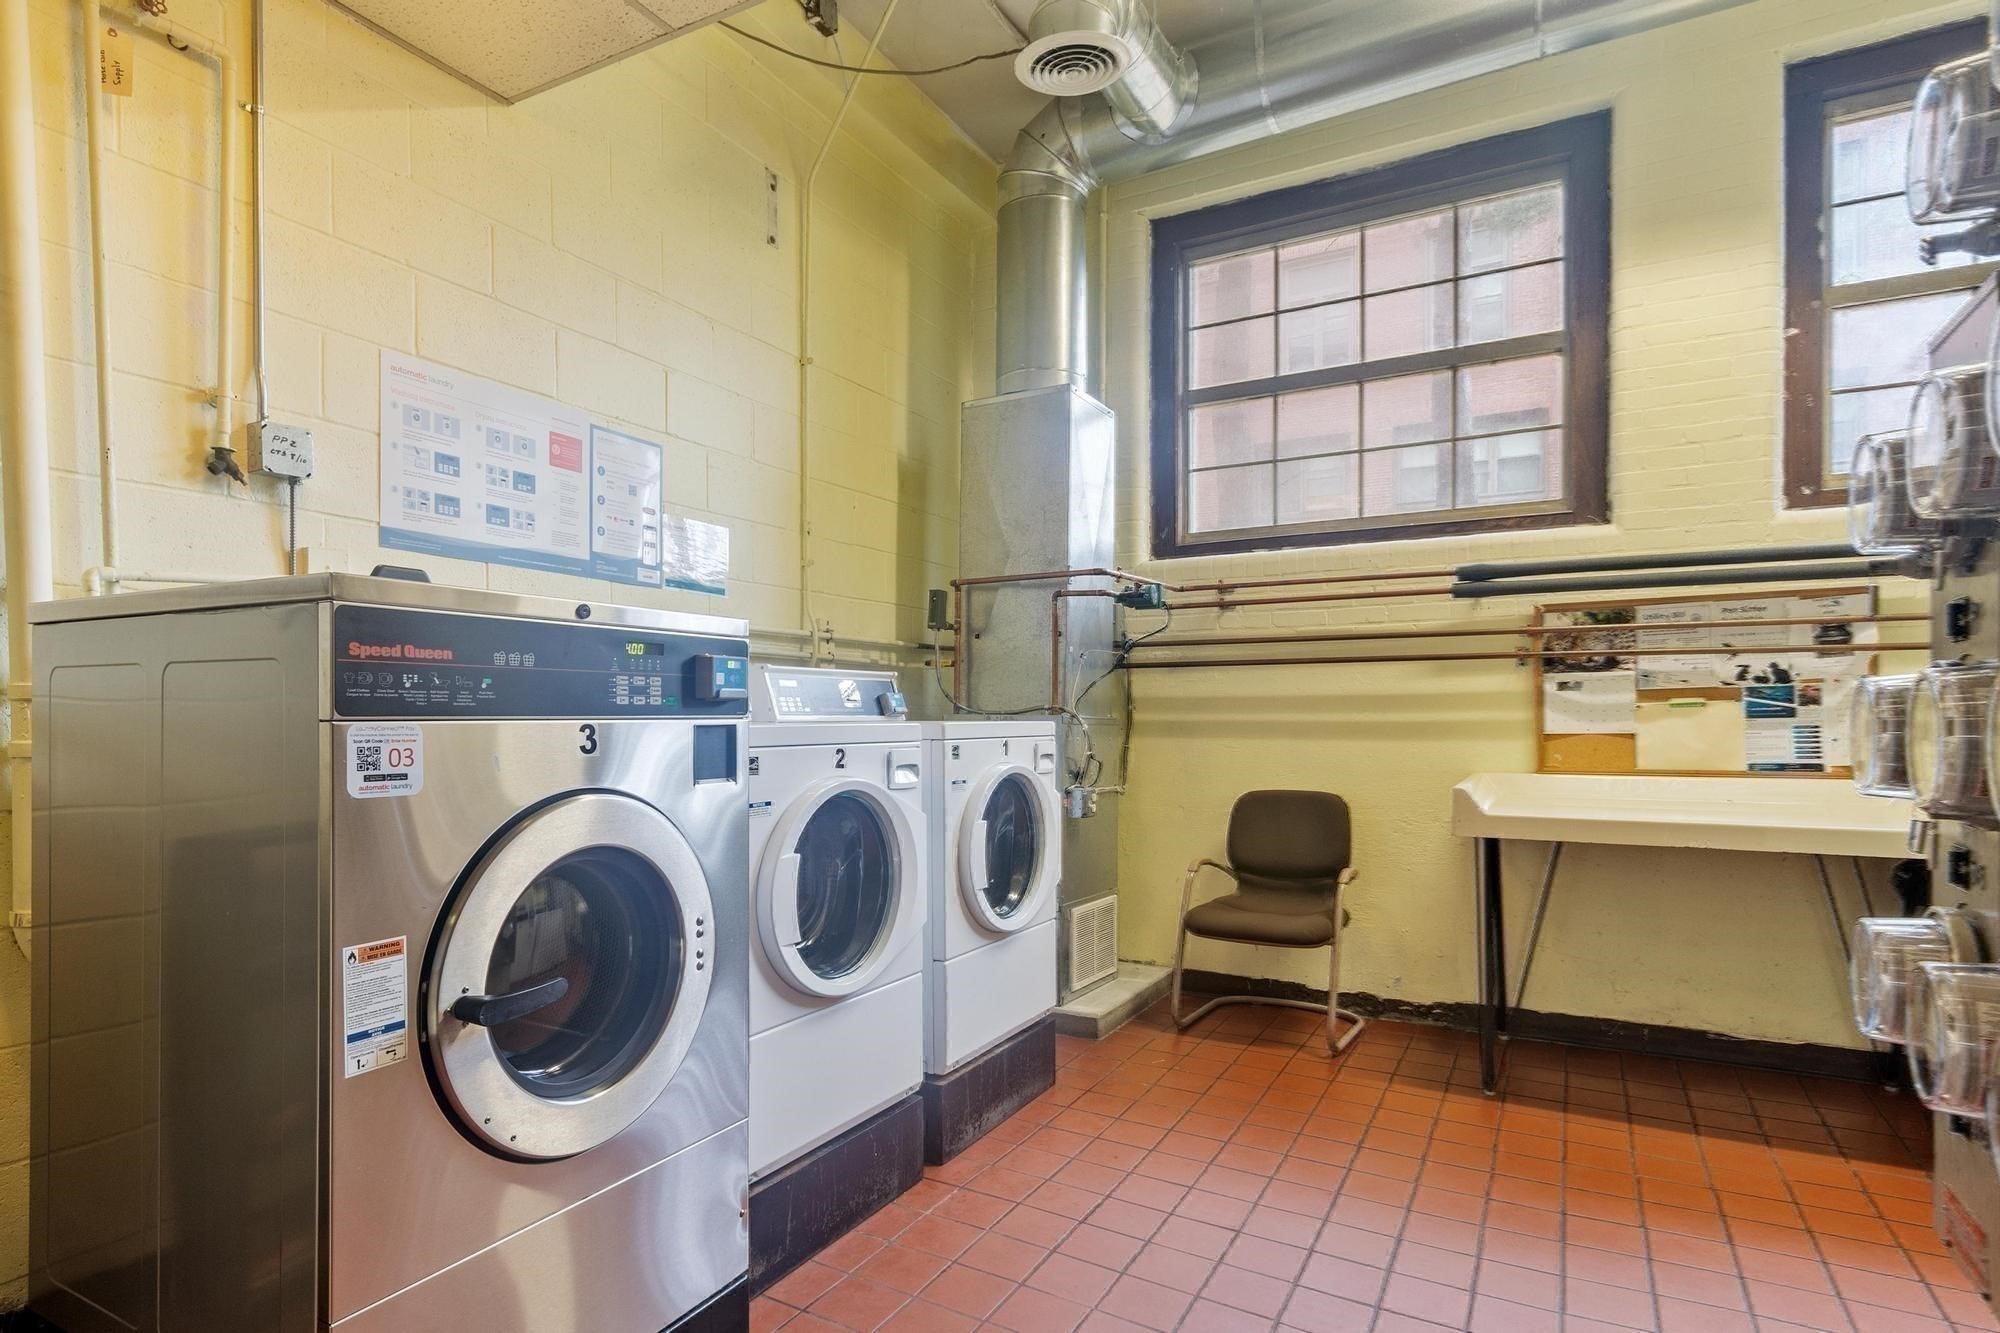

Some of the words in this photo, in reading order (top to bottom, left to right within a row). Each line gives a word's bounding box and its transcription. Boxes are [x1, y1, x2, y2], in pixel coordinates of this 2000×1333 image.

[390, 363, 428, 381] automatic
[428, 375, 456, 391] laundry
[348, 641, 402, 659] Speed
[404, 644, 454, 660] Queen
[579, 723, 598, 755] 3
[1002, 739, 1009, 756] 1
[388, 747, 415, 768] 03
[834, 748, 846, 769] 2
[358, 784, 390, 792] automatic
[368, 941, 401, 952] WARNING
